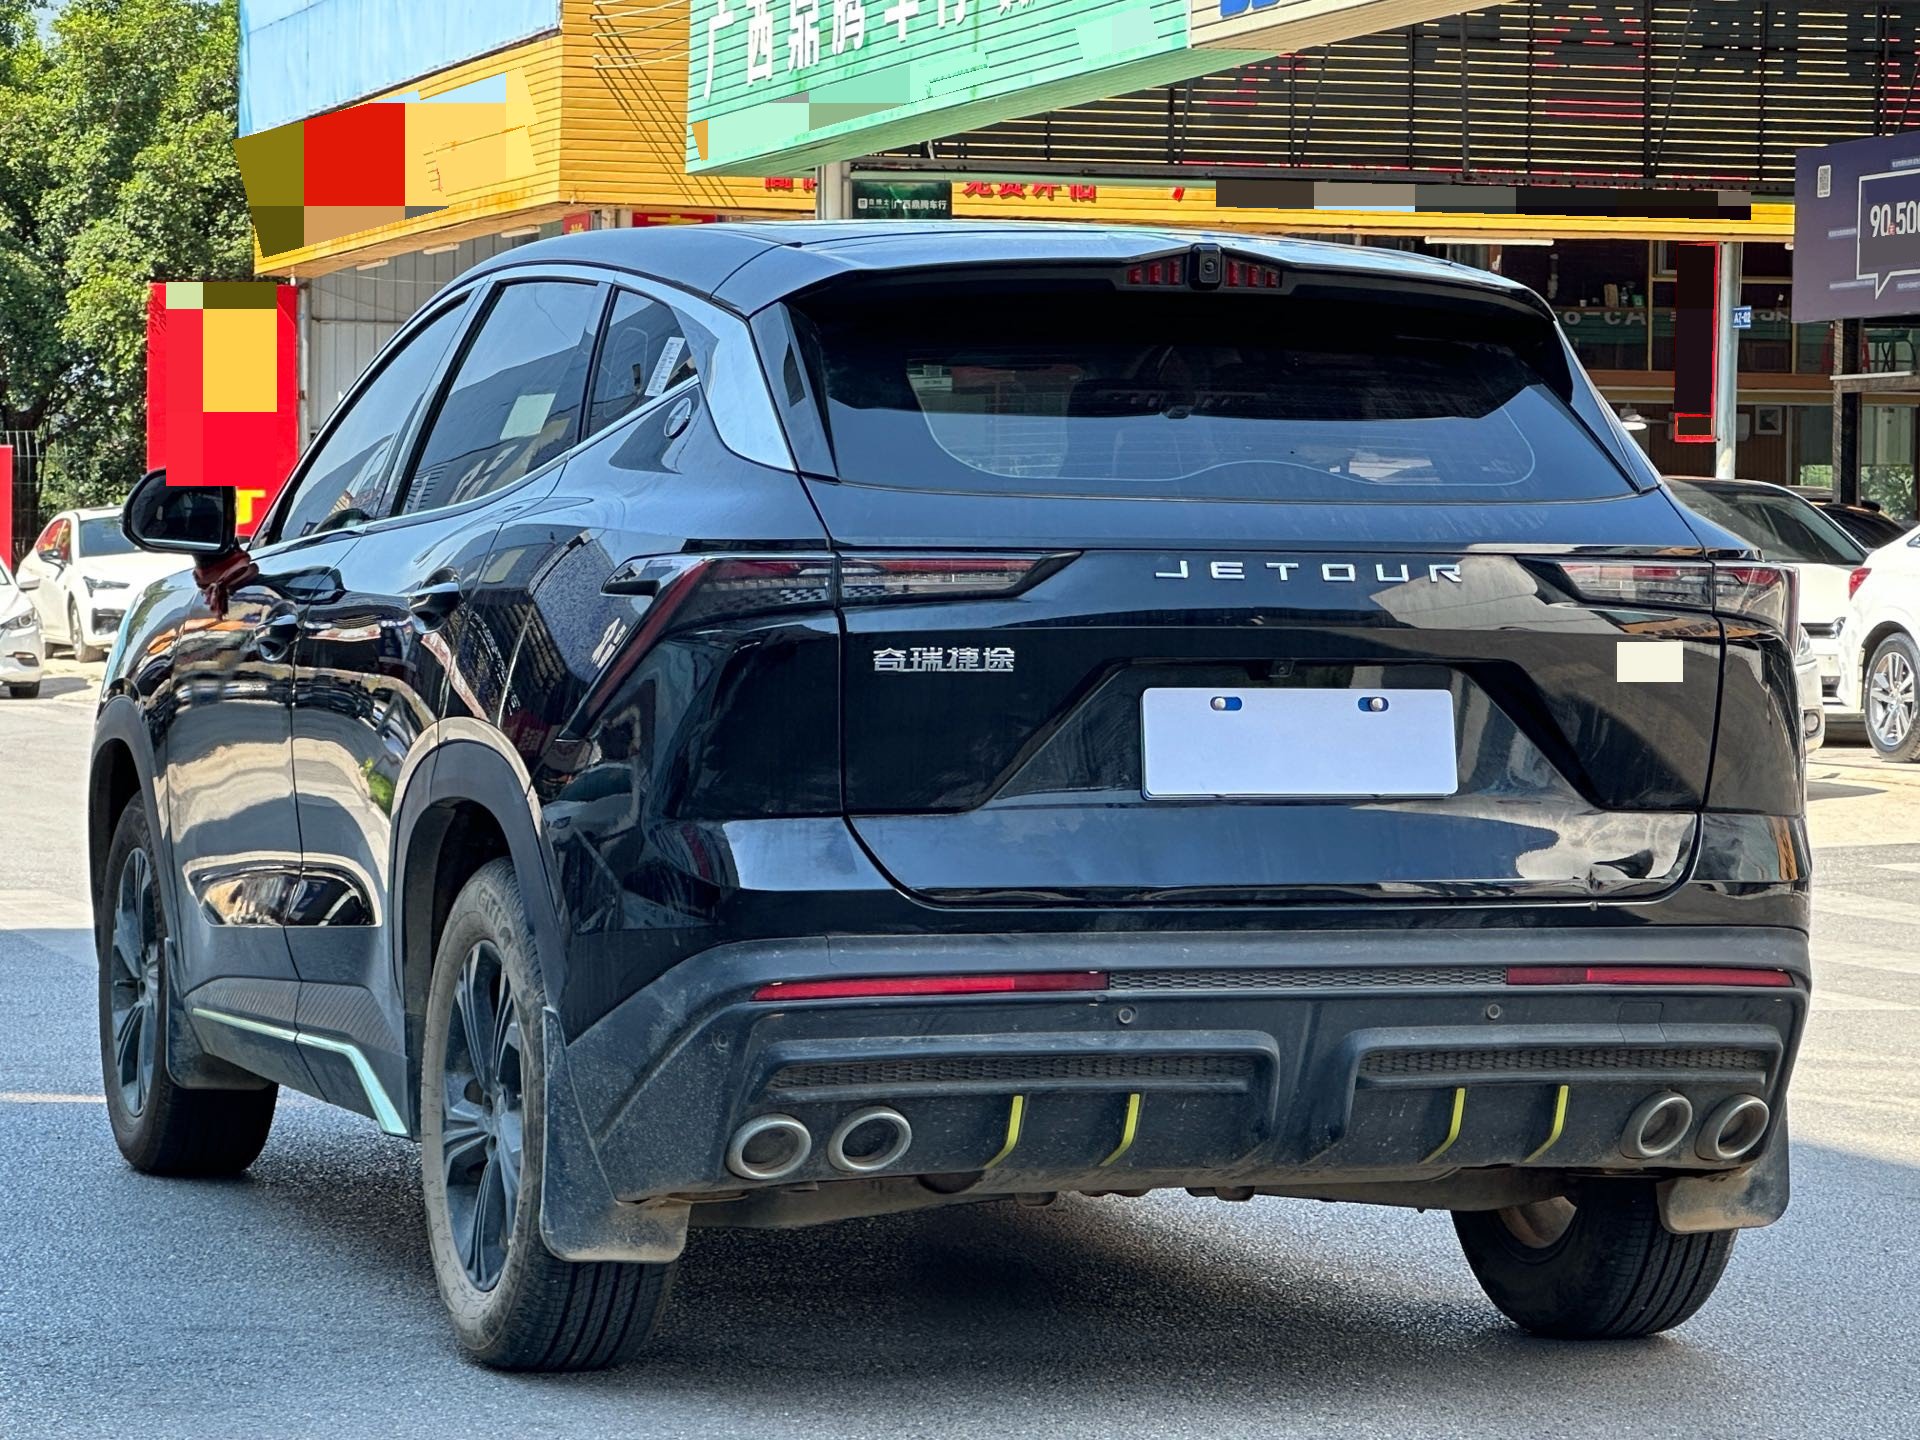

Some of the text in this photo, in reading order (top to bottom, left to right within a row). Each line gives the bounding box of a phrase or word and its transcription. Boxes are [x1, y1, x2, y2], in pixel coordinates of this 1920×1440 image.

[1155, 559, 1463, 583] JETOUR
[872, 646, 1016, 673] 奇瑞捷途
